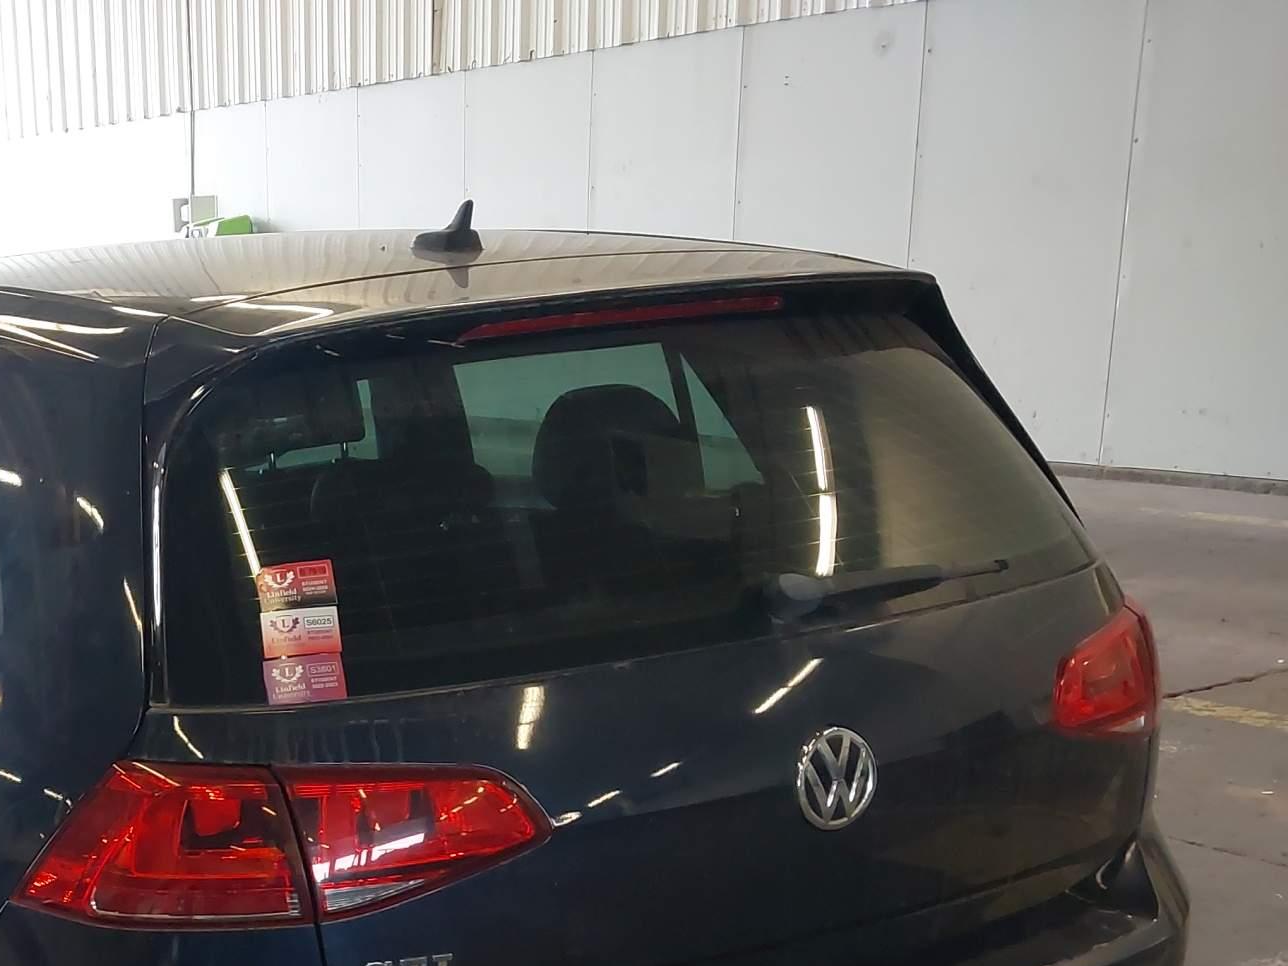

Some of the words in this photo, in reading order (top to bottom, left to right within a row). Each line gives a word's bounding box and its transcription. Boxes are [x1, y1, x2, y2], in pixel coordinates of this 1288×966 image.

[267, 588, 297, 598] Linfield
[275, 683, 306, 693] Linfield
[800, 731, 873, 826] VW
